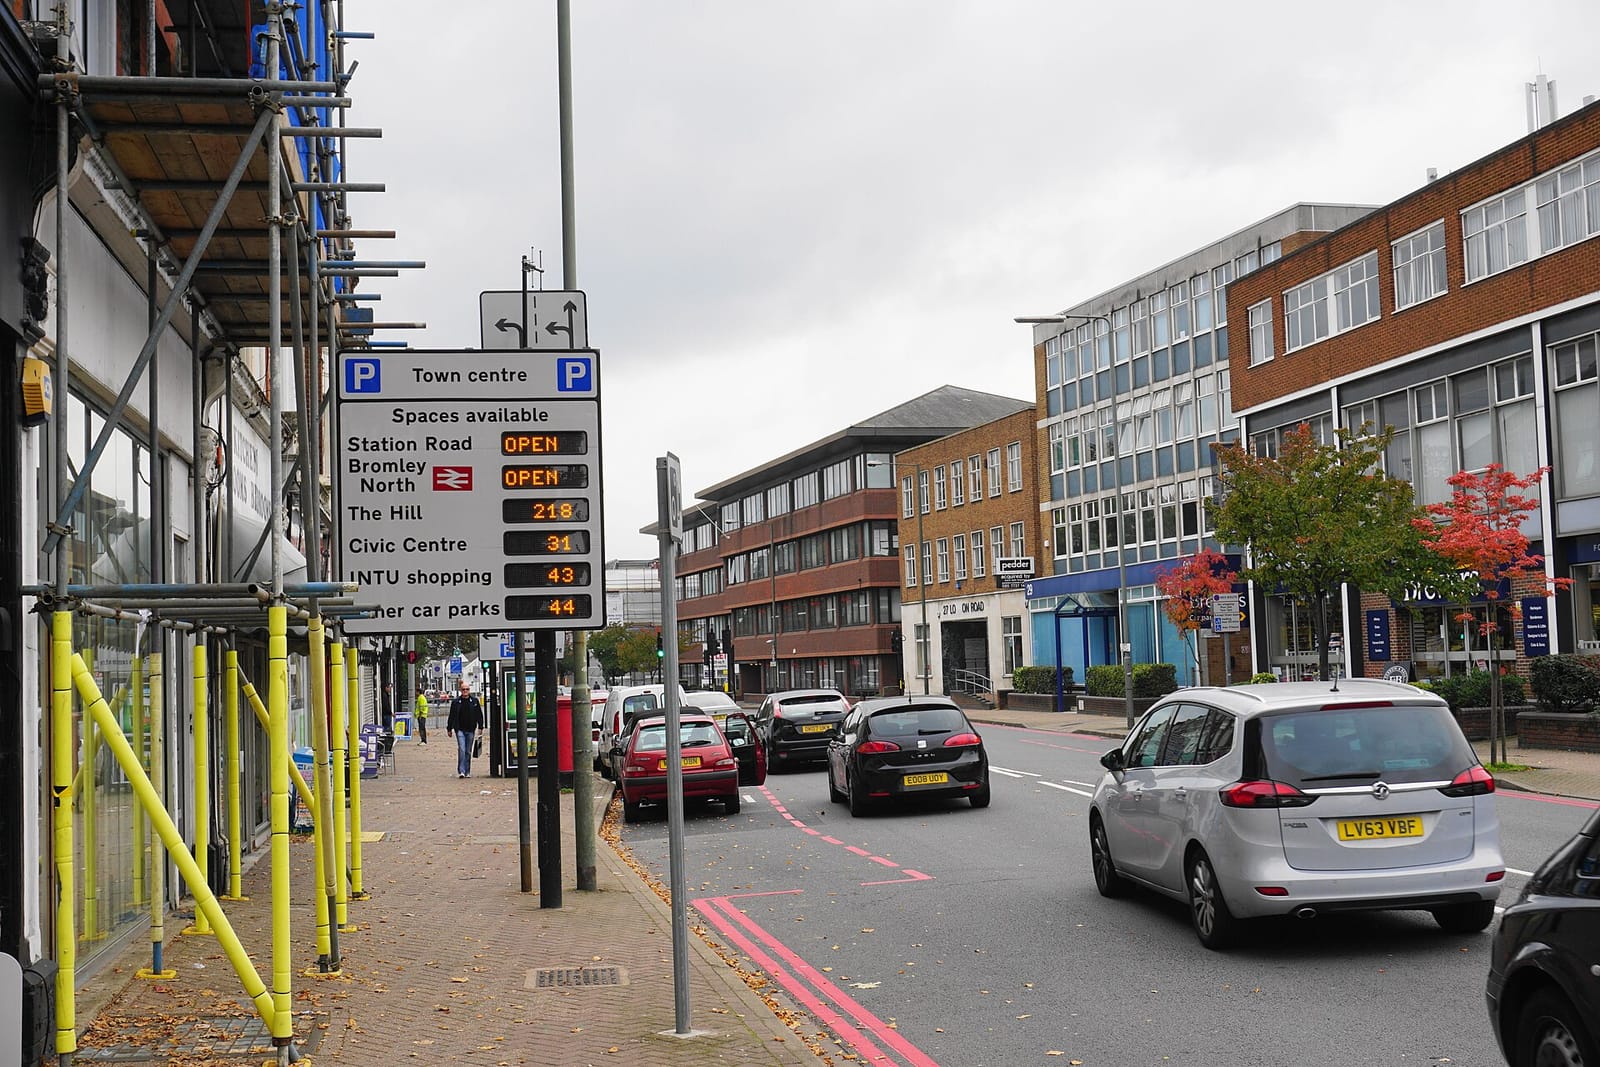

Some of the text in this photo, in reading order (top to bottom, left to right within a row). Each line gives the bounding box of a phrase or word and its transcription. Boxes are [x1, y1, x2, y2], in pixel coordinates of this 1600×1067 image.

[354, 362, 376, 390] P
[412, 367, 528, 383] Town centre
[565, 361, 587, 389] P
[391, 407, 549, 426] Spaces available
[347, 435, 473, 452] Station Road
[505, 436, 558, 453] OPEN
[348, 457, 427, 475] Bromley
[360, 477, 416, 493] North
[505, 469, 558, 486] OPEN
[347, 504, 423, 521] The Hill
[533, 502, 573, 519] 218
[348, 537, 468, 554] Civic Centre
[547, 535, 572, 551] 31
[1002, 560, 1029, 572] pedder
[350, 568, 492, 587] INTU shopping
[548, 567, 574, 583] 43
[1026, 584, 1033, 596] 29
[411, 605, 441, 618] car
[448, 600, 500, 619] parks
[549, 599, 575, 615] 44
[943, 605, 949, 615] 27
[970, 601, 984, 612] ROAD
[1344, 820, 1416, 837] LV63 VBF
